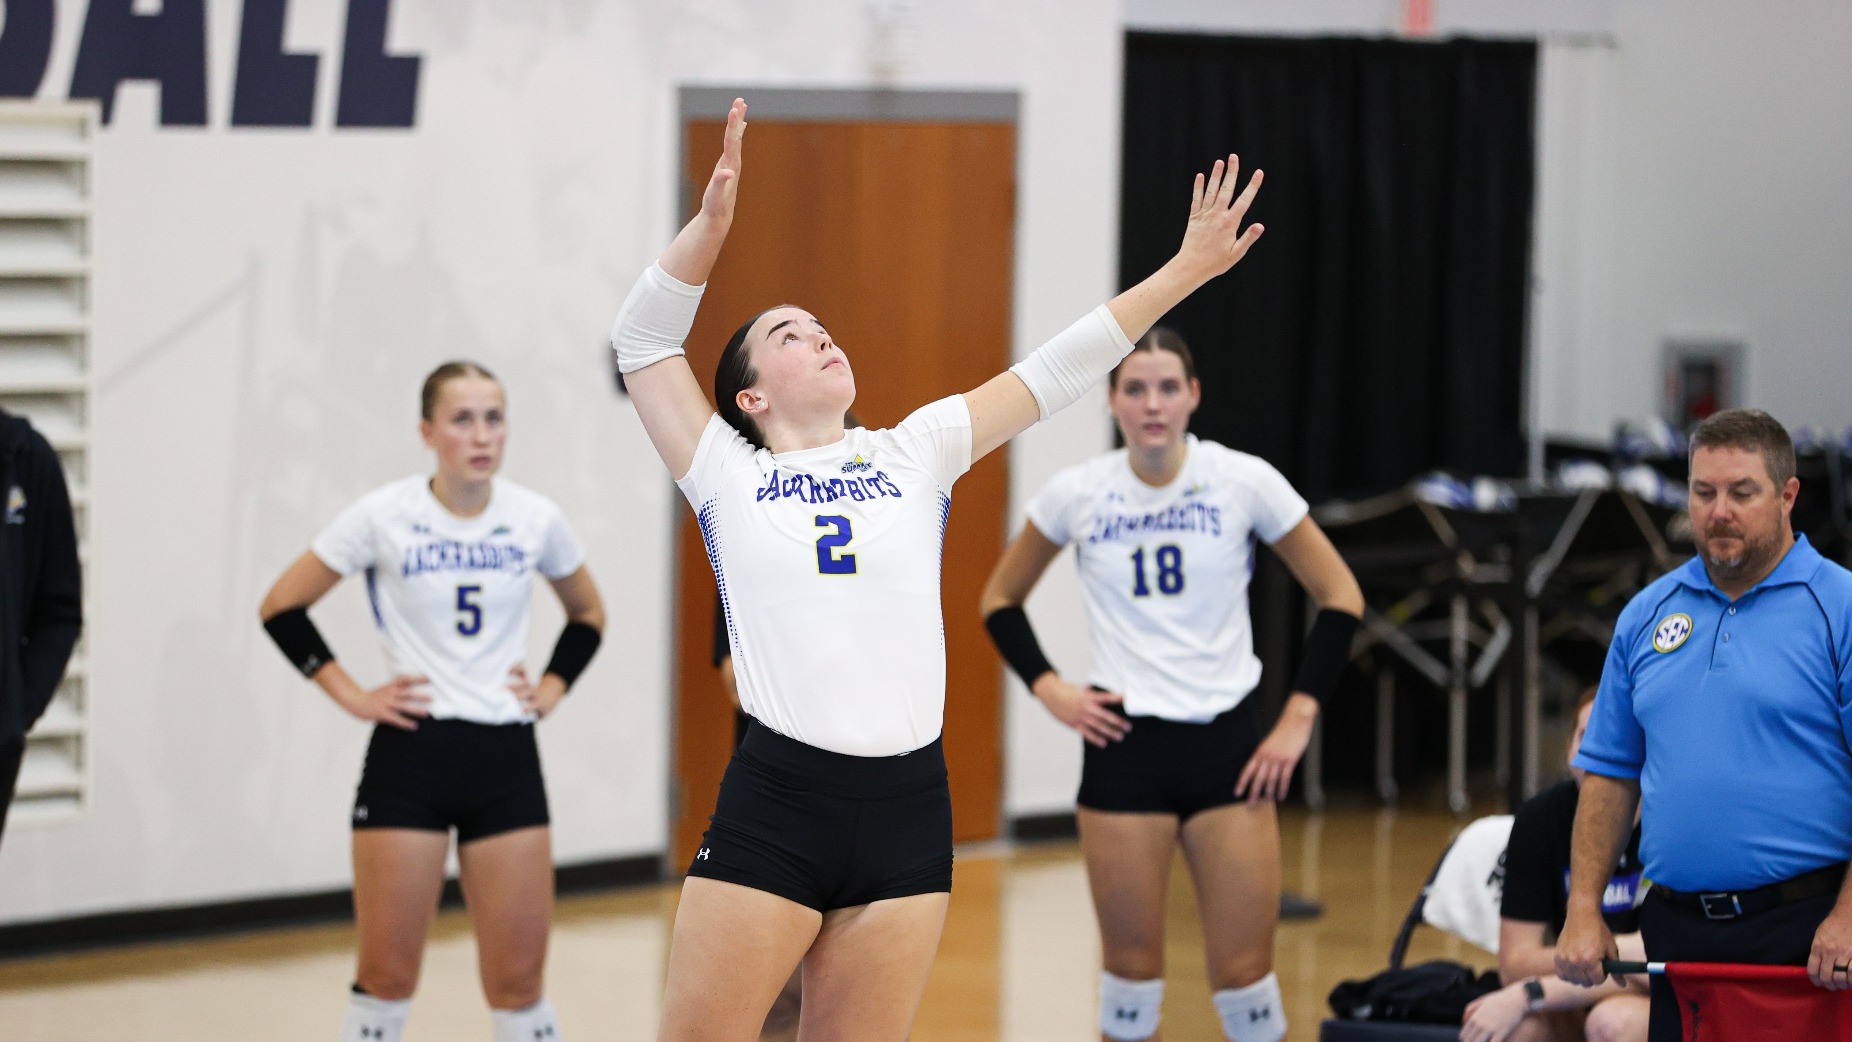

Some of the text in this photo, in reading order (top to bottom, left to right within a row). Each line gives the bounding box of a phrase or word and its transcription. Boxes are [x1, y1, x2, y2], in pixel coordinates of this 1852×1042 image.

[814, 514, 859, 576] 2
[1130, 543, 1186, 597] 18
[456, 584, 483, 637] 5
[1654, 614, 1690, 650] SEC
